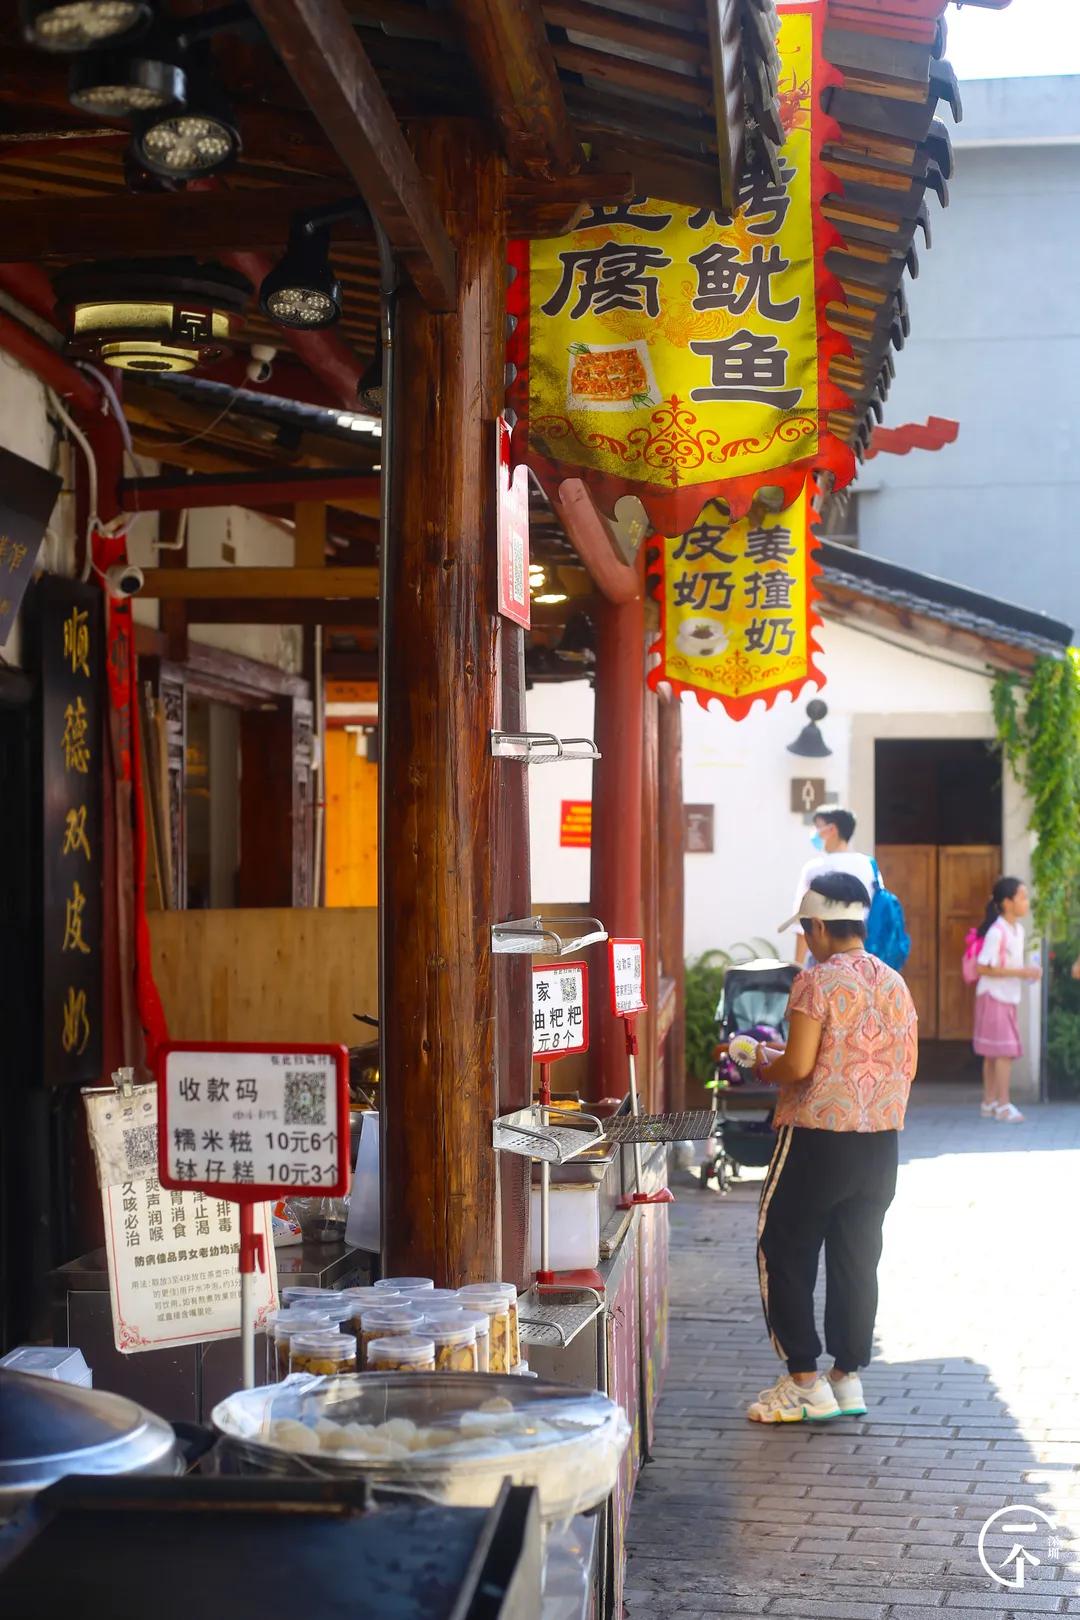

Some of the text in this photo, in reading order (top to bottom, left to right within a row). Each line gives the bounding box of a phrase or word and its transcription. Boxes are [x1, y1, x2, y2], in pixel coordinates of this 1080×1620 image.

[672, 498, 738, 612] 皮奶
[744, 524, 796, 656] 姜撞奶
[536, 981, 551, 1002] 家
[533, 1030, 575, 1052] 元8个
[179, 1077, 258, 1103] 收款码
[265, 1130, 338, 1154] 10元6个
[267, 1163, 338, 1187] 10元3个
[121, 1181, 140, 1248] 久咳必治
